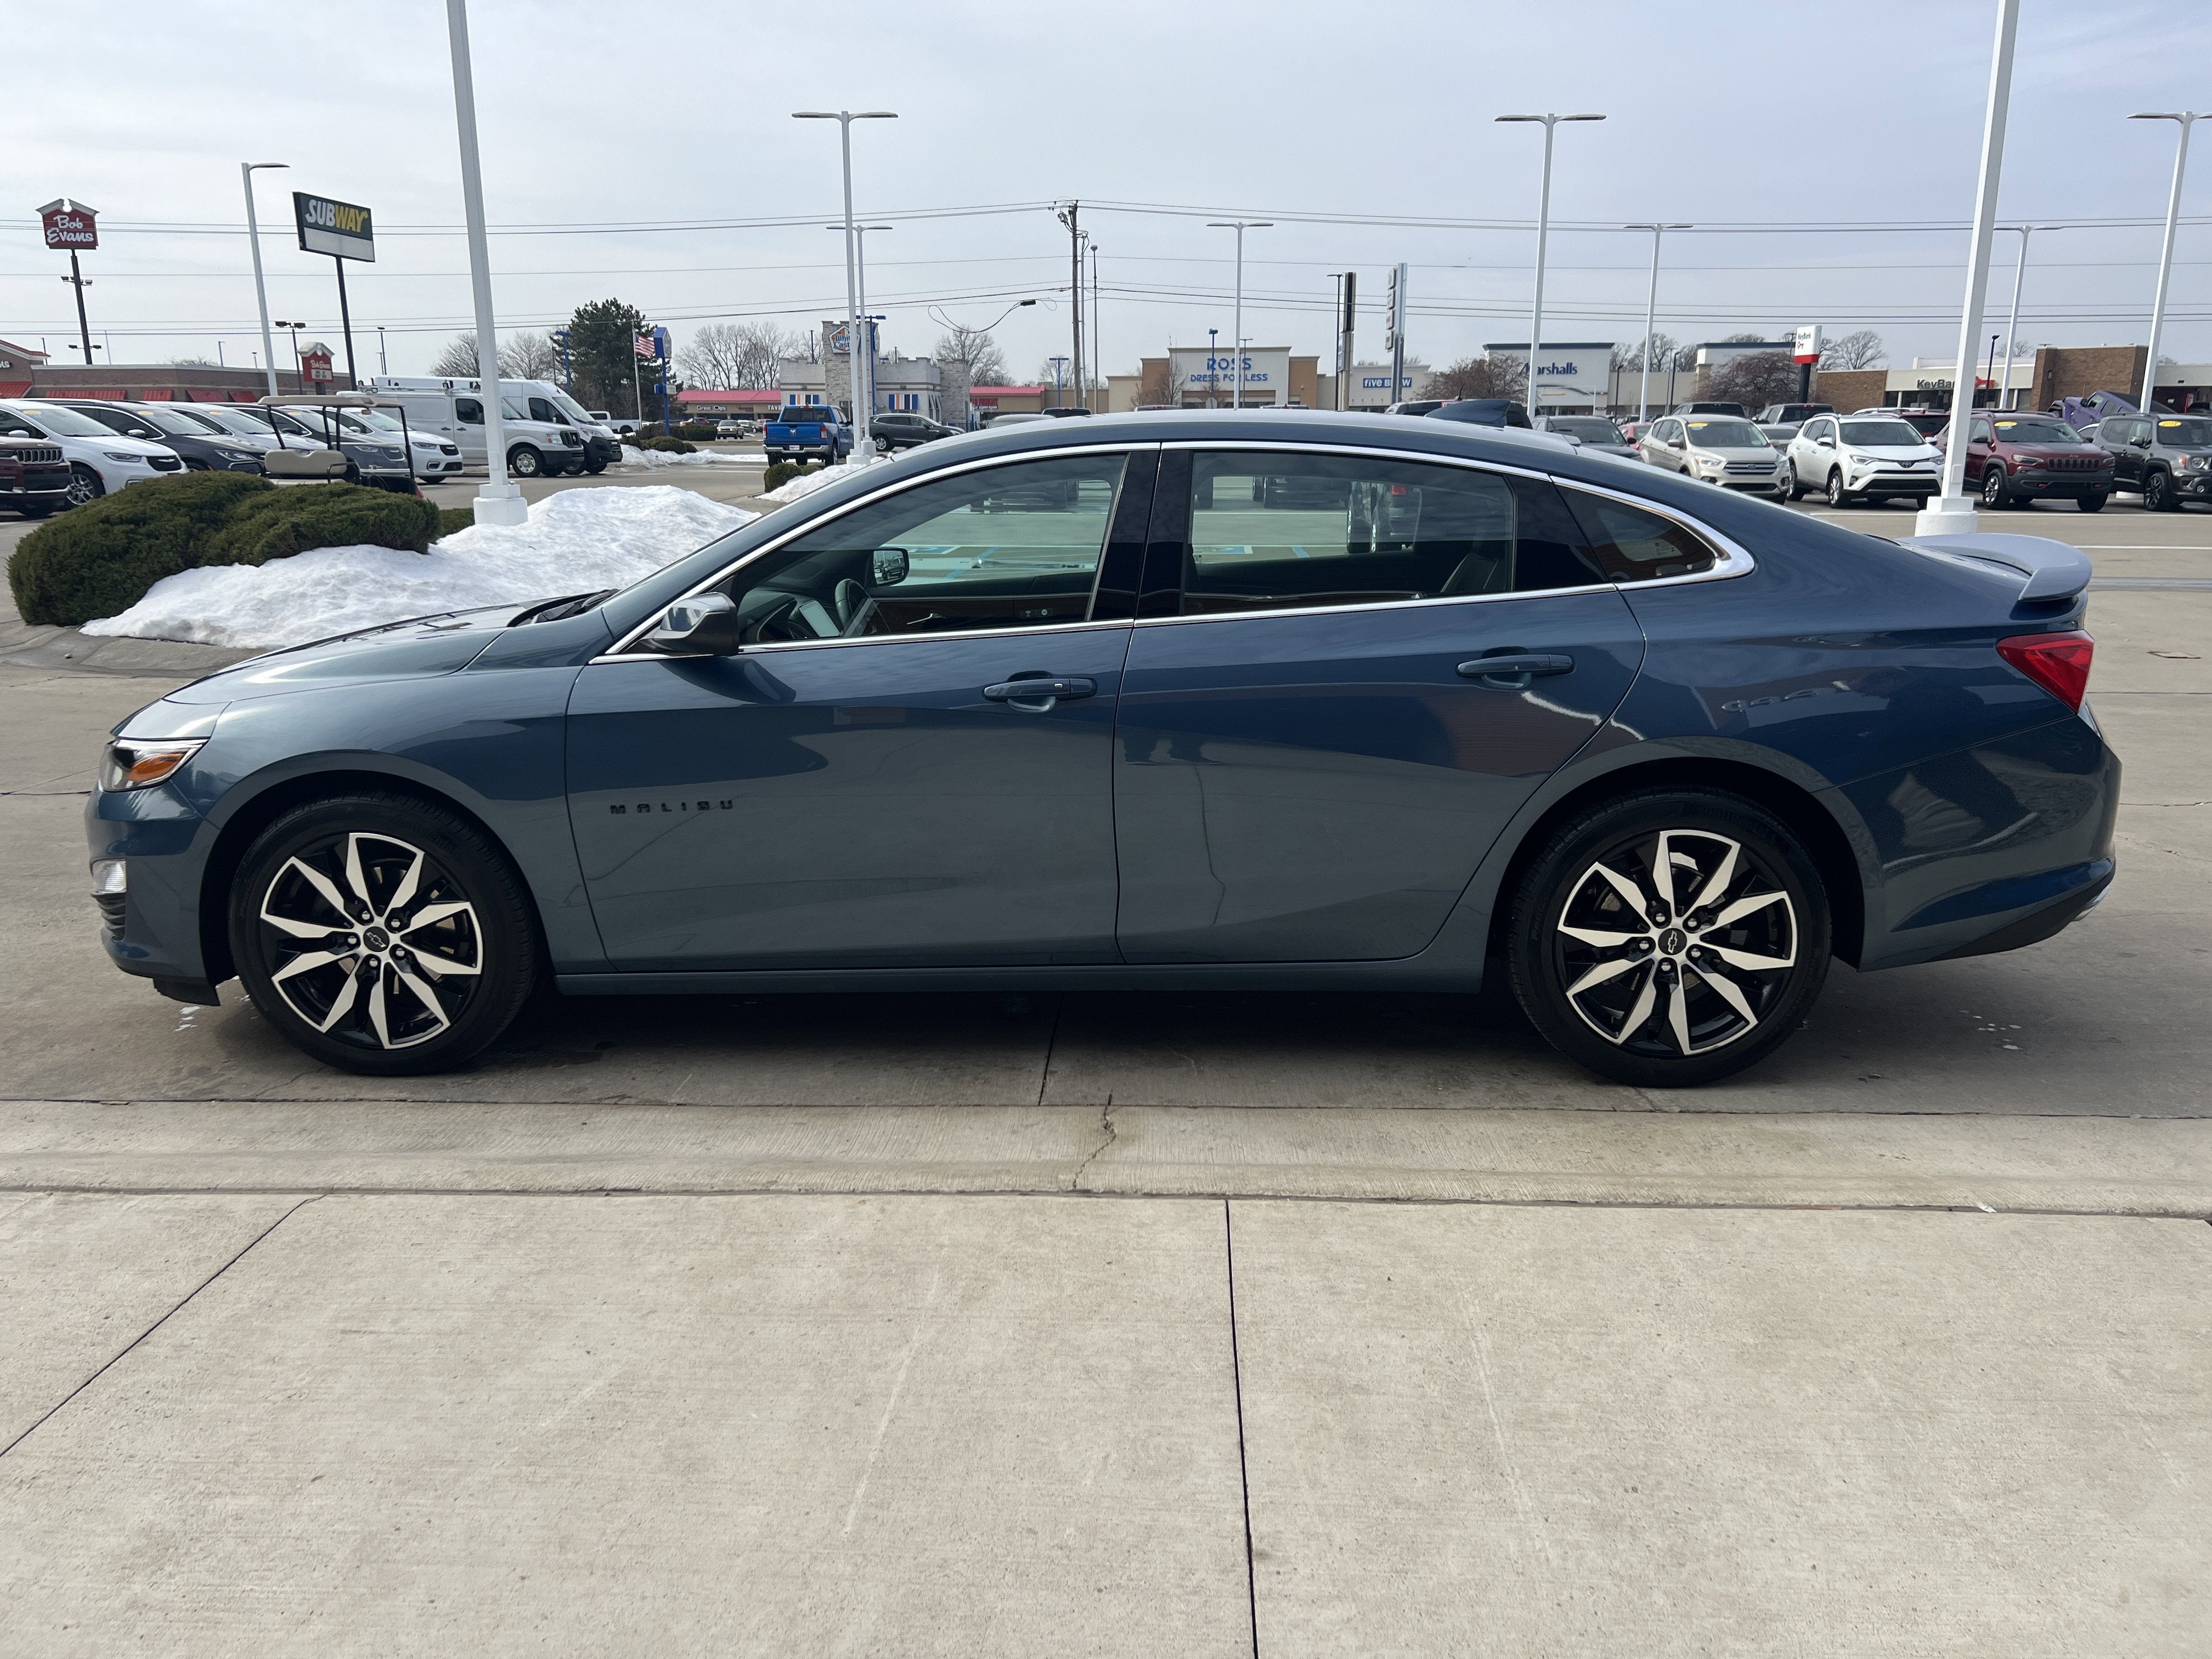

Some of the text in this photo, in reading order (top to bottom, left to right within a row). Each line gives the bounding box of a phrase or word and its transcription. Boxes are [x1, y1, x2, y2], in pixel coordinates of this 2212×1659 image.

[53, 215, 83, 229] Bob
[305, 199, 368, 232] SUBWAY
[47, 228, 94, 243] Evans
[1364, 379, 1383, 387] five
[1917, 379, 1955, 390] KeyBa
[611, 800, 732, 814] MALIBU
